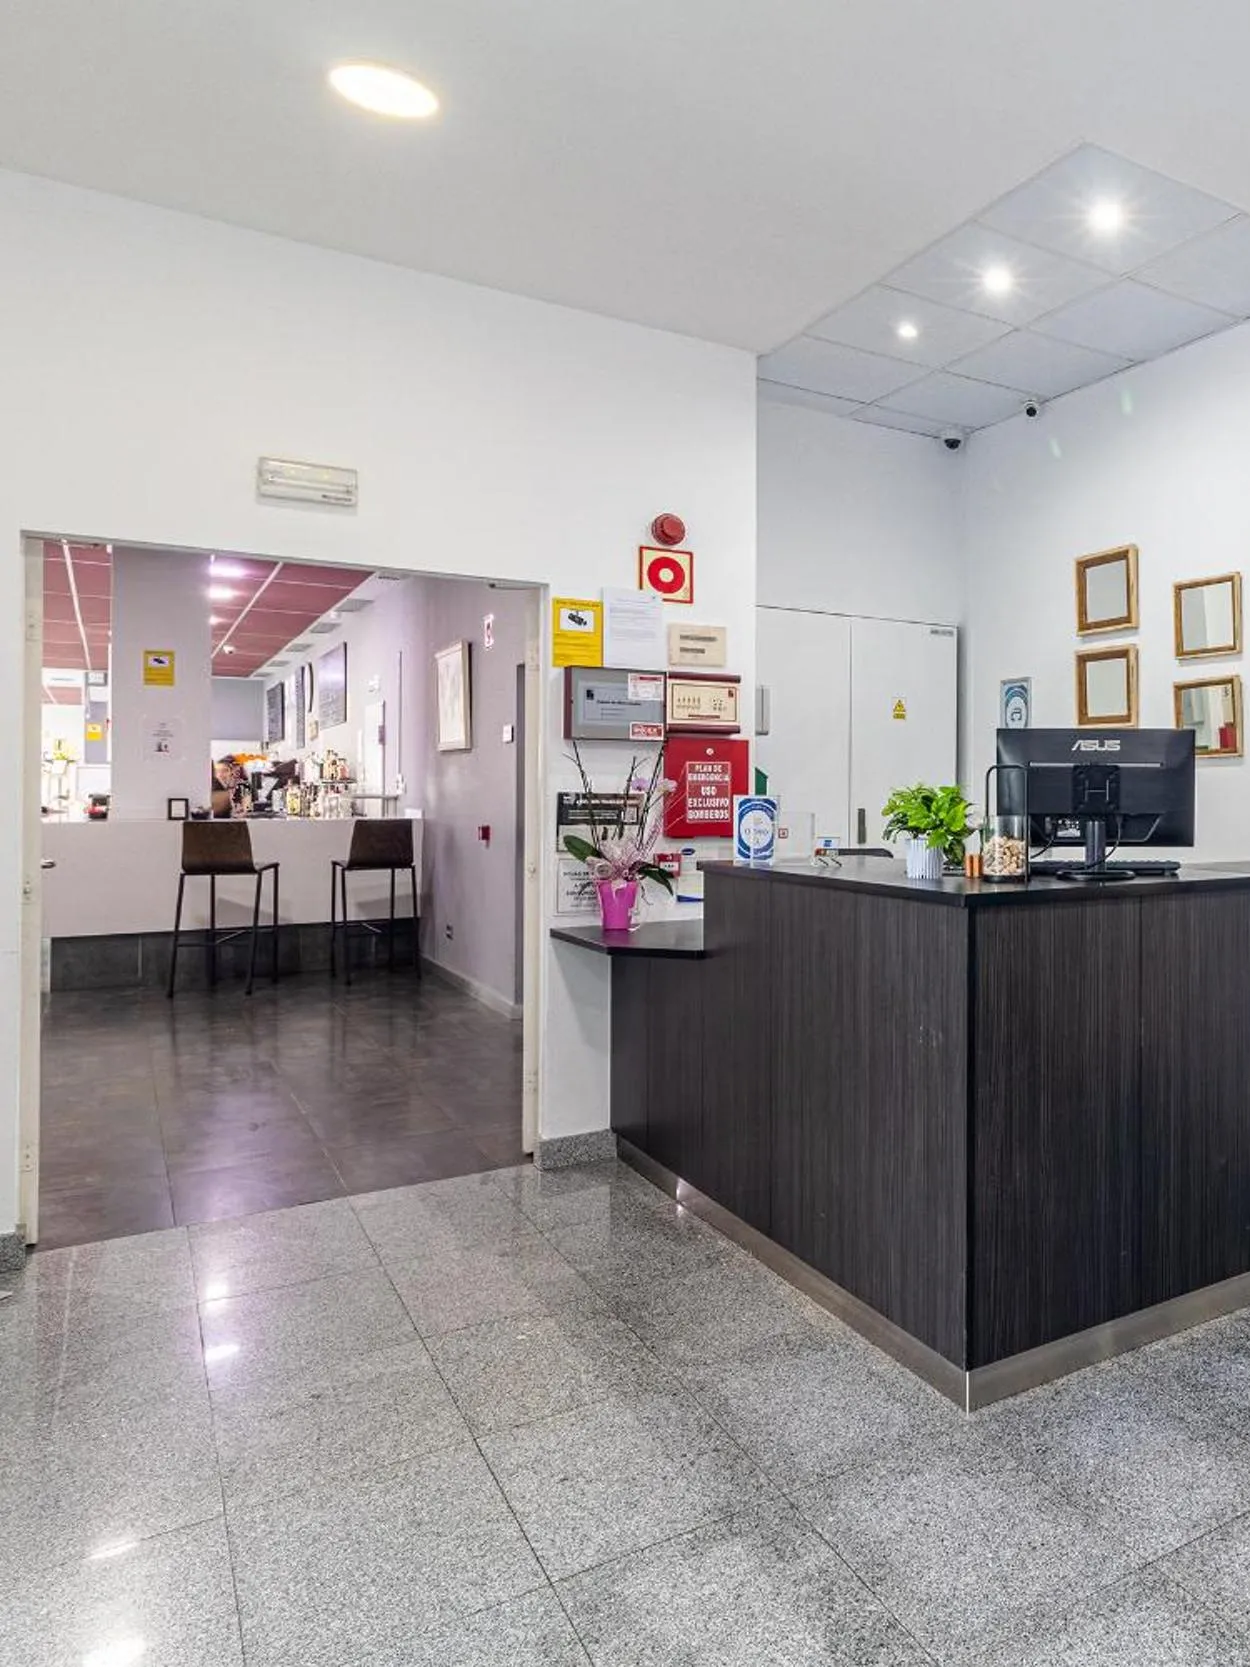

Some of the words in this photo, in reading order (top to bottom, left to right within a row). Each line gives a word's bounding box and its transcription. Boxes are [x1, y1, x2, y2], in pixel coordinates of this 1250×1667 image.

[1071, 739, 1121, 751] ASUS
[701, 786, 717, 796] USO
[687, 798, 729, 807] EXCLUSIVO
[687, 809, 729, 819] BOMBEROS
